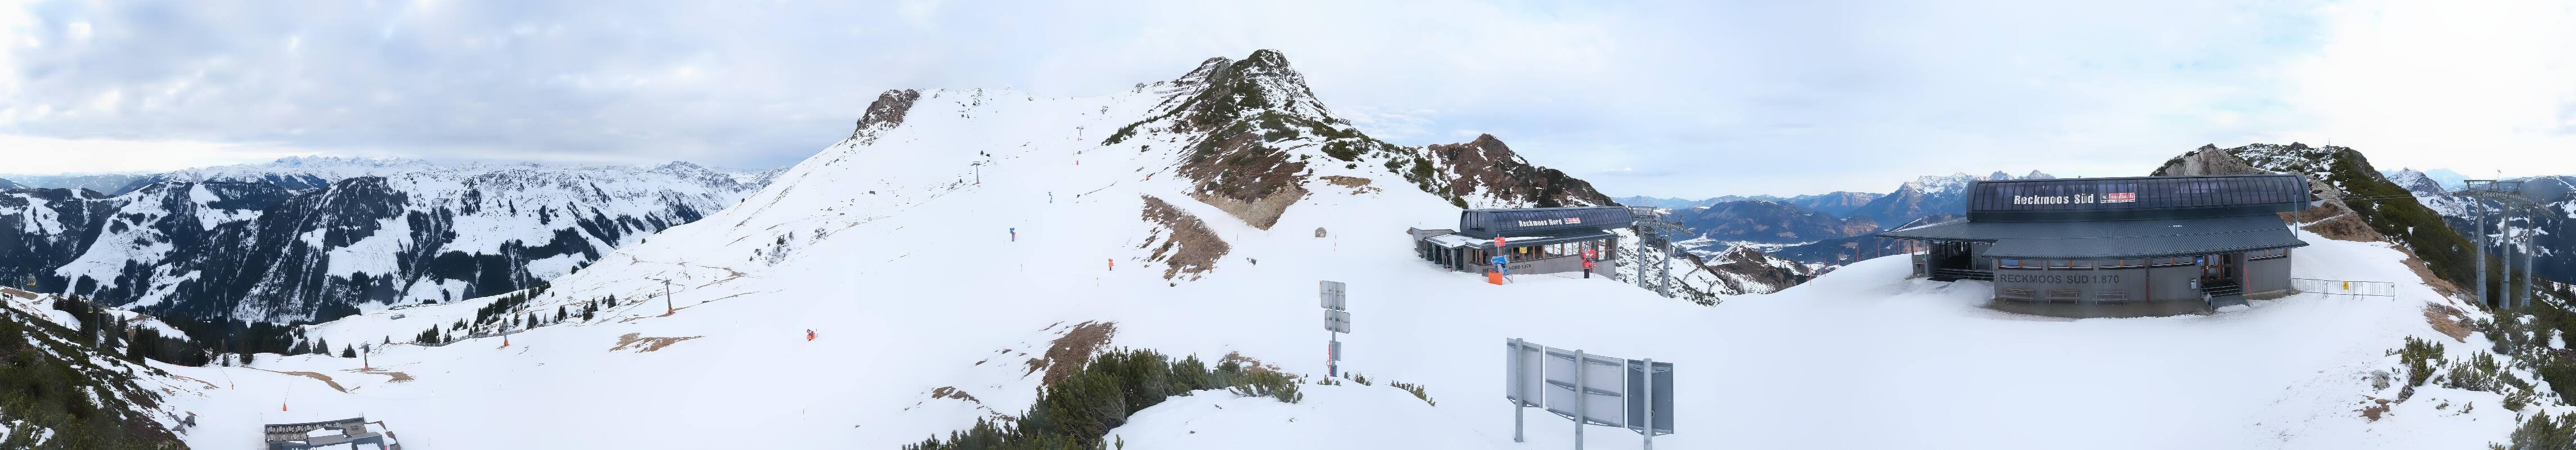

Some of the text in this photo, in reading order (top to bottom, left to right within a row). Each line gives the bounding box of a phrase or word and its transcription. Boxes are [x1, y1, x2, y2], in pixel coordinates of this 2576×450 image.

[2014, 194, 2094, 205] Reckmoos Süd
[2000, 274, 2119, 284] RECKMOOS SÜD 1.870
